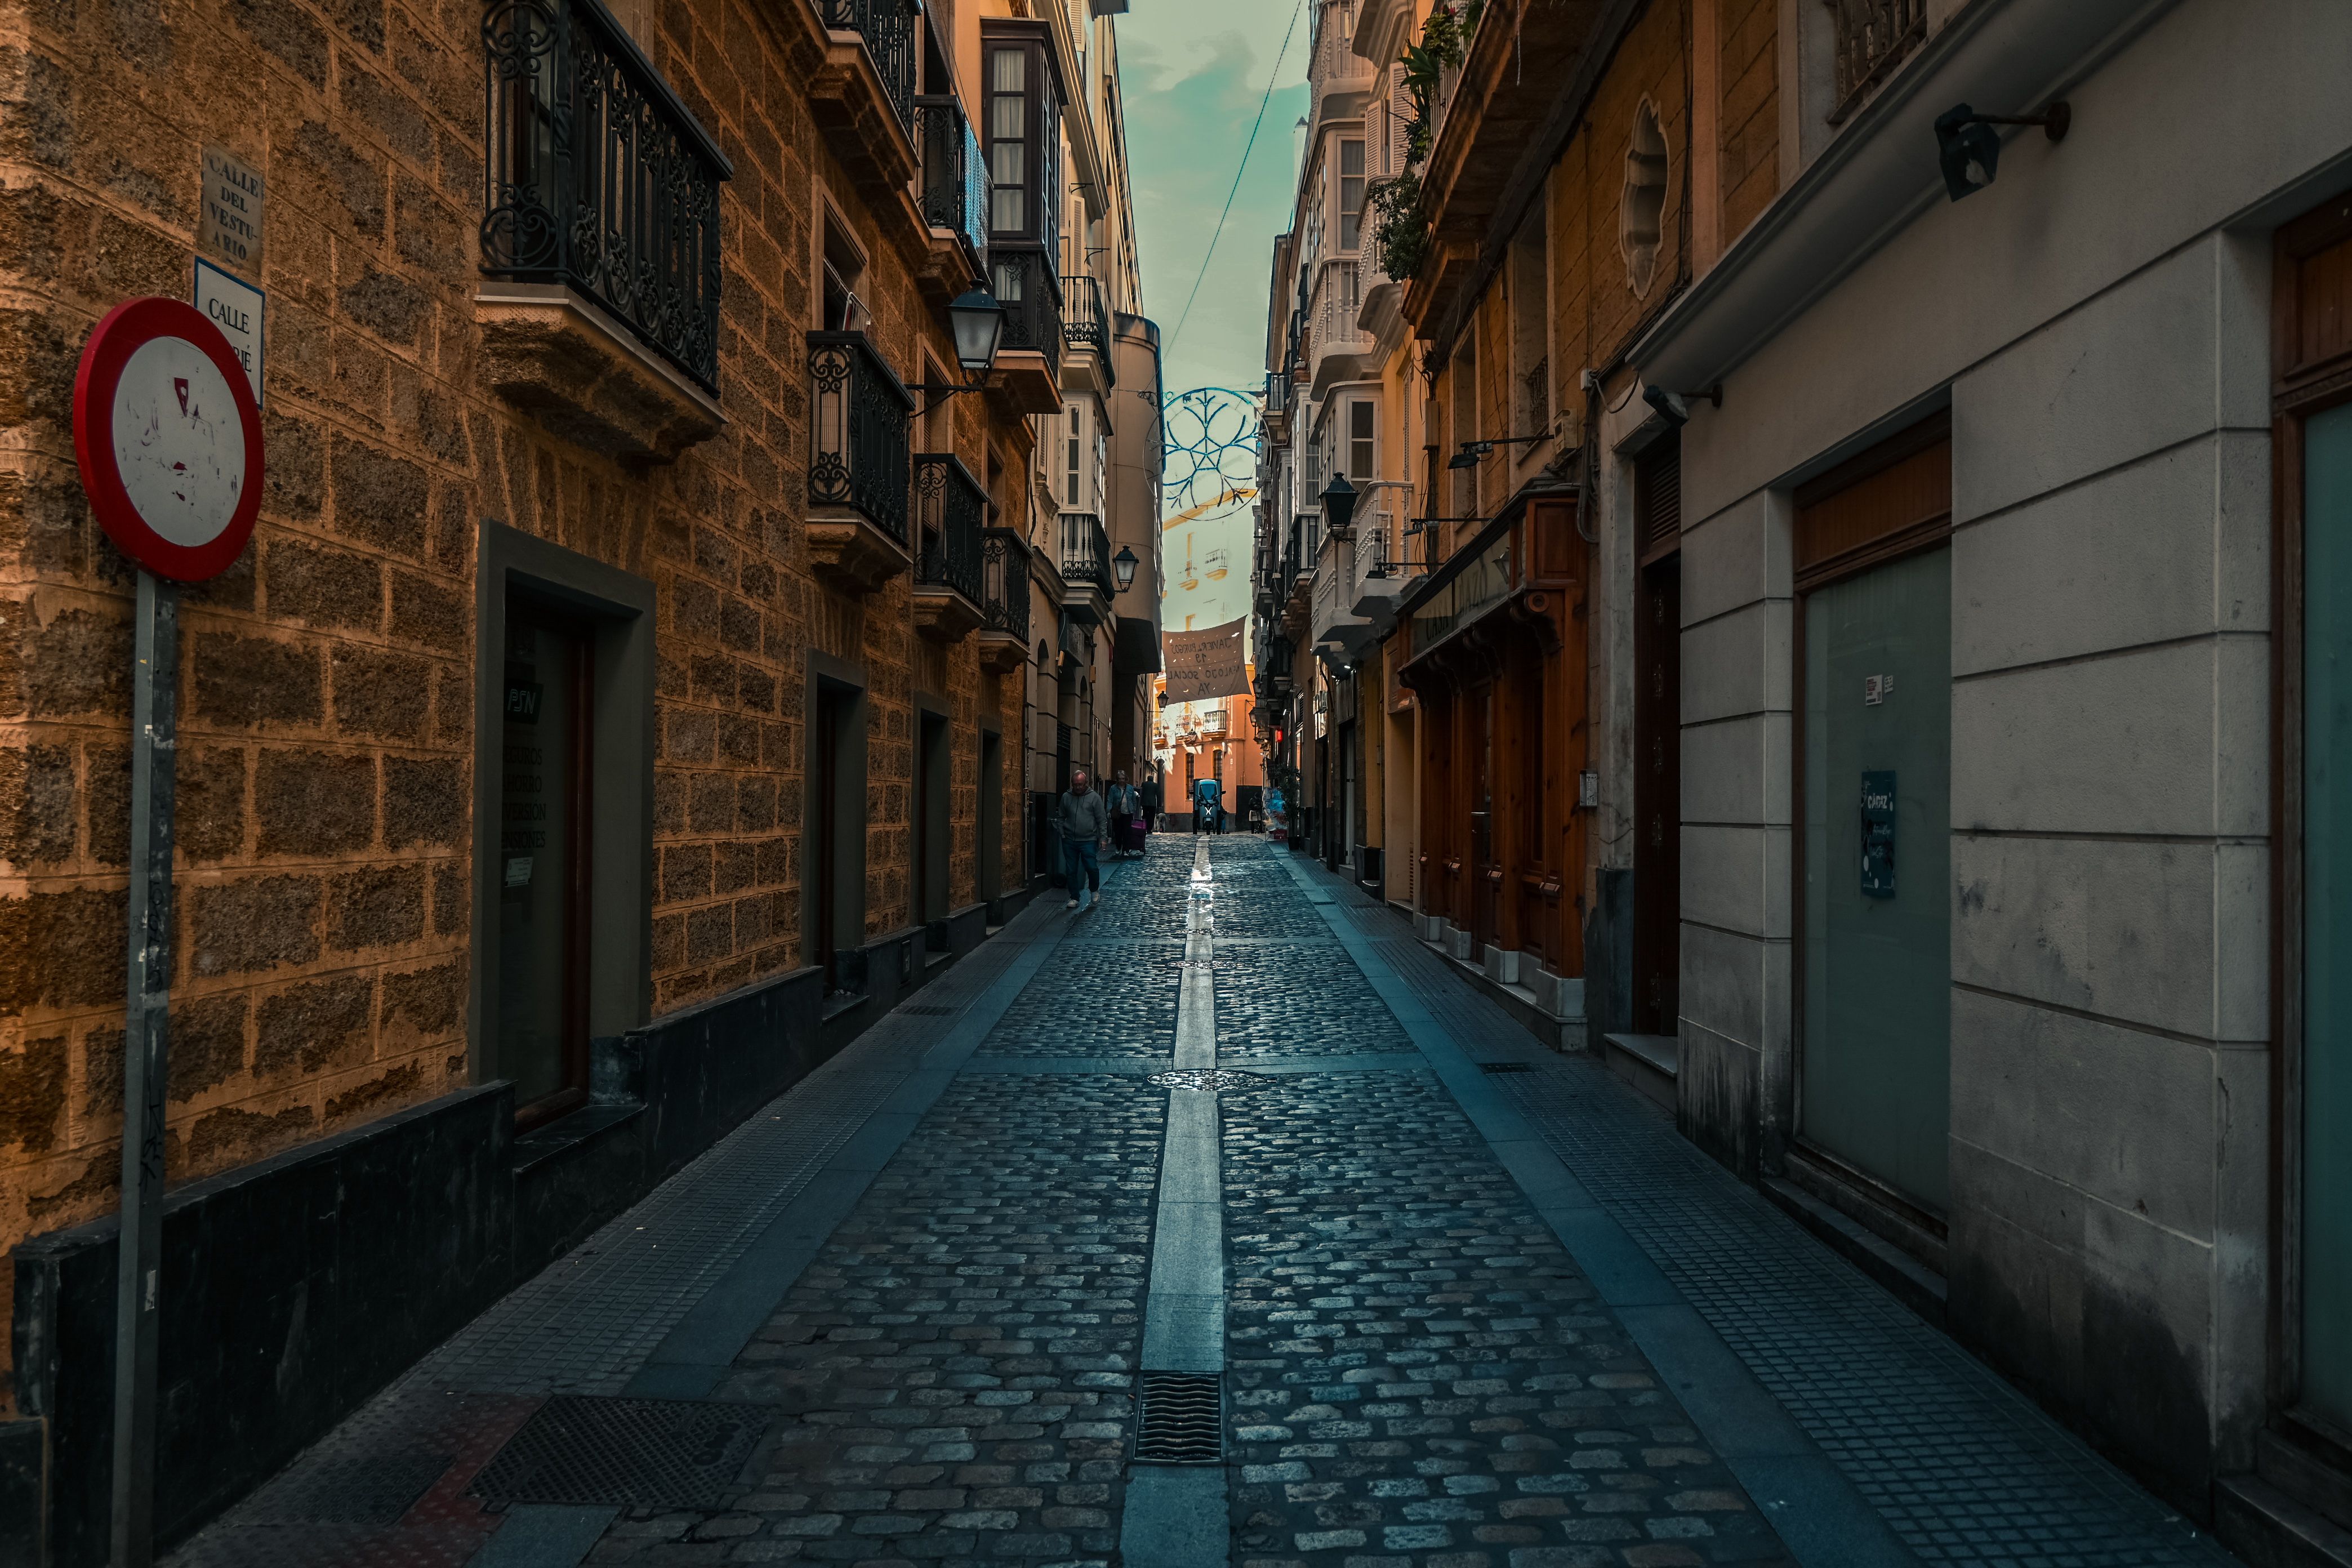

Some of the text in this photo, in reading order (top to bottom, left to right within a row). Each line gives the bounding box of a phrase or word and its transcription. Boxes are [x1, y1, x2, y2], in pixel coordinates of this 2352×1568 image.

[209, 157, 259, 197] CALLE
[221, 185, 248, 213] DEL
[210, 202, 257, 240] VESTU-
[213, 231, 247, 260] ARIO
[209, 298, 250, 335] CALLE
[1426, 595, 1449, 642] CASA
[507, 688, 536, 715] PSN
